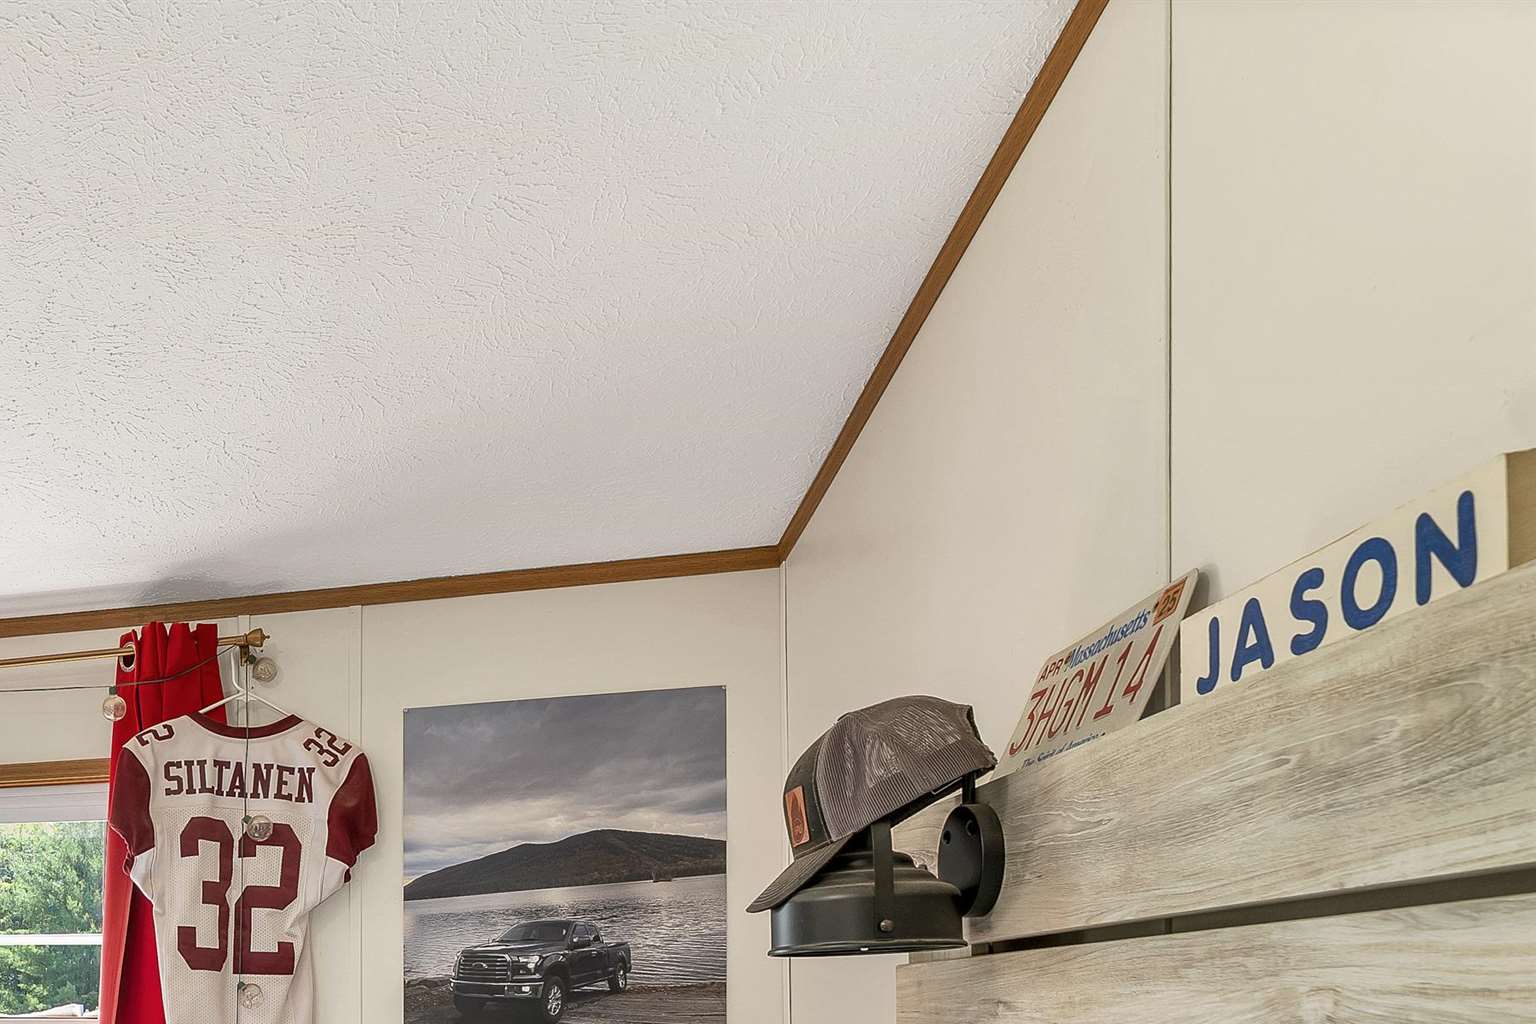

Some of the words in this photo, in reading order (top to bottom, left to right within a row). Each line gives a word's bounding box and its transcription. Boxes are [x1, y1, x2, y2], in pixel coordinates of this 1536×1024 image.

[1196, 490, 1477, 695] JASON
[1038, 657, 1064, 684] APR
[1064, 608, 1151, 673] Massachusetts
[164, 759, 315, 803] SILTANEN
[302, 726, 353, 768] 32
[177, 816, 302, 975] 32
